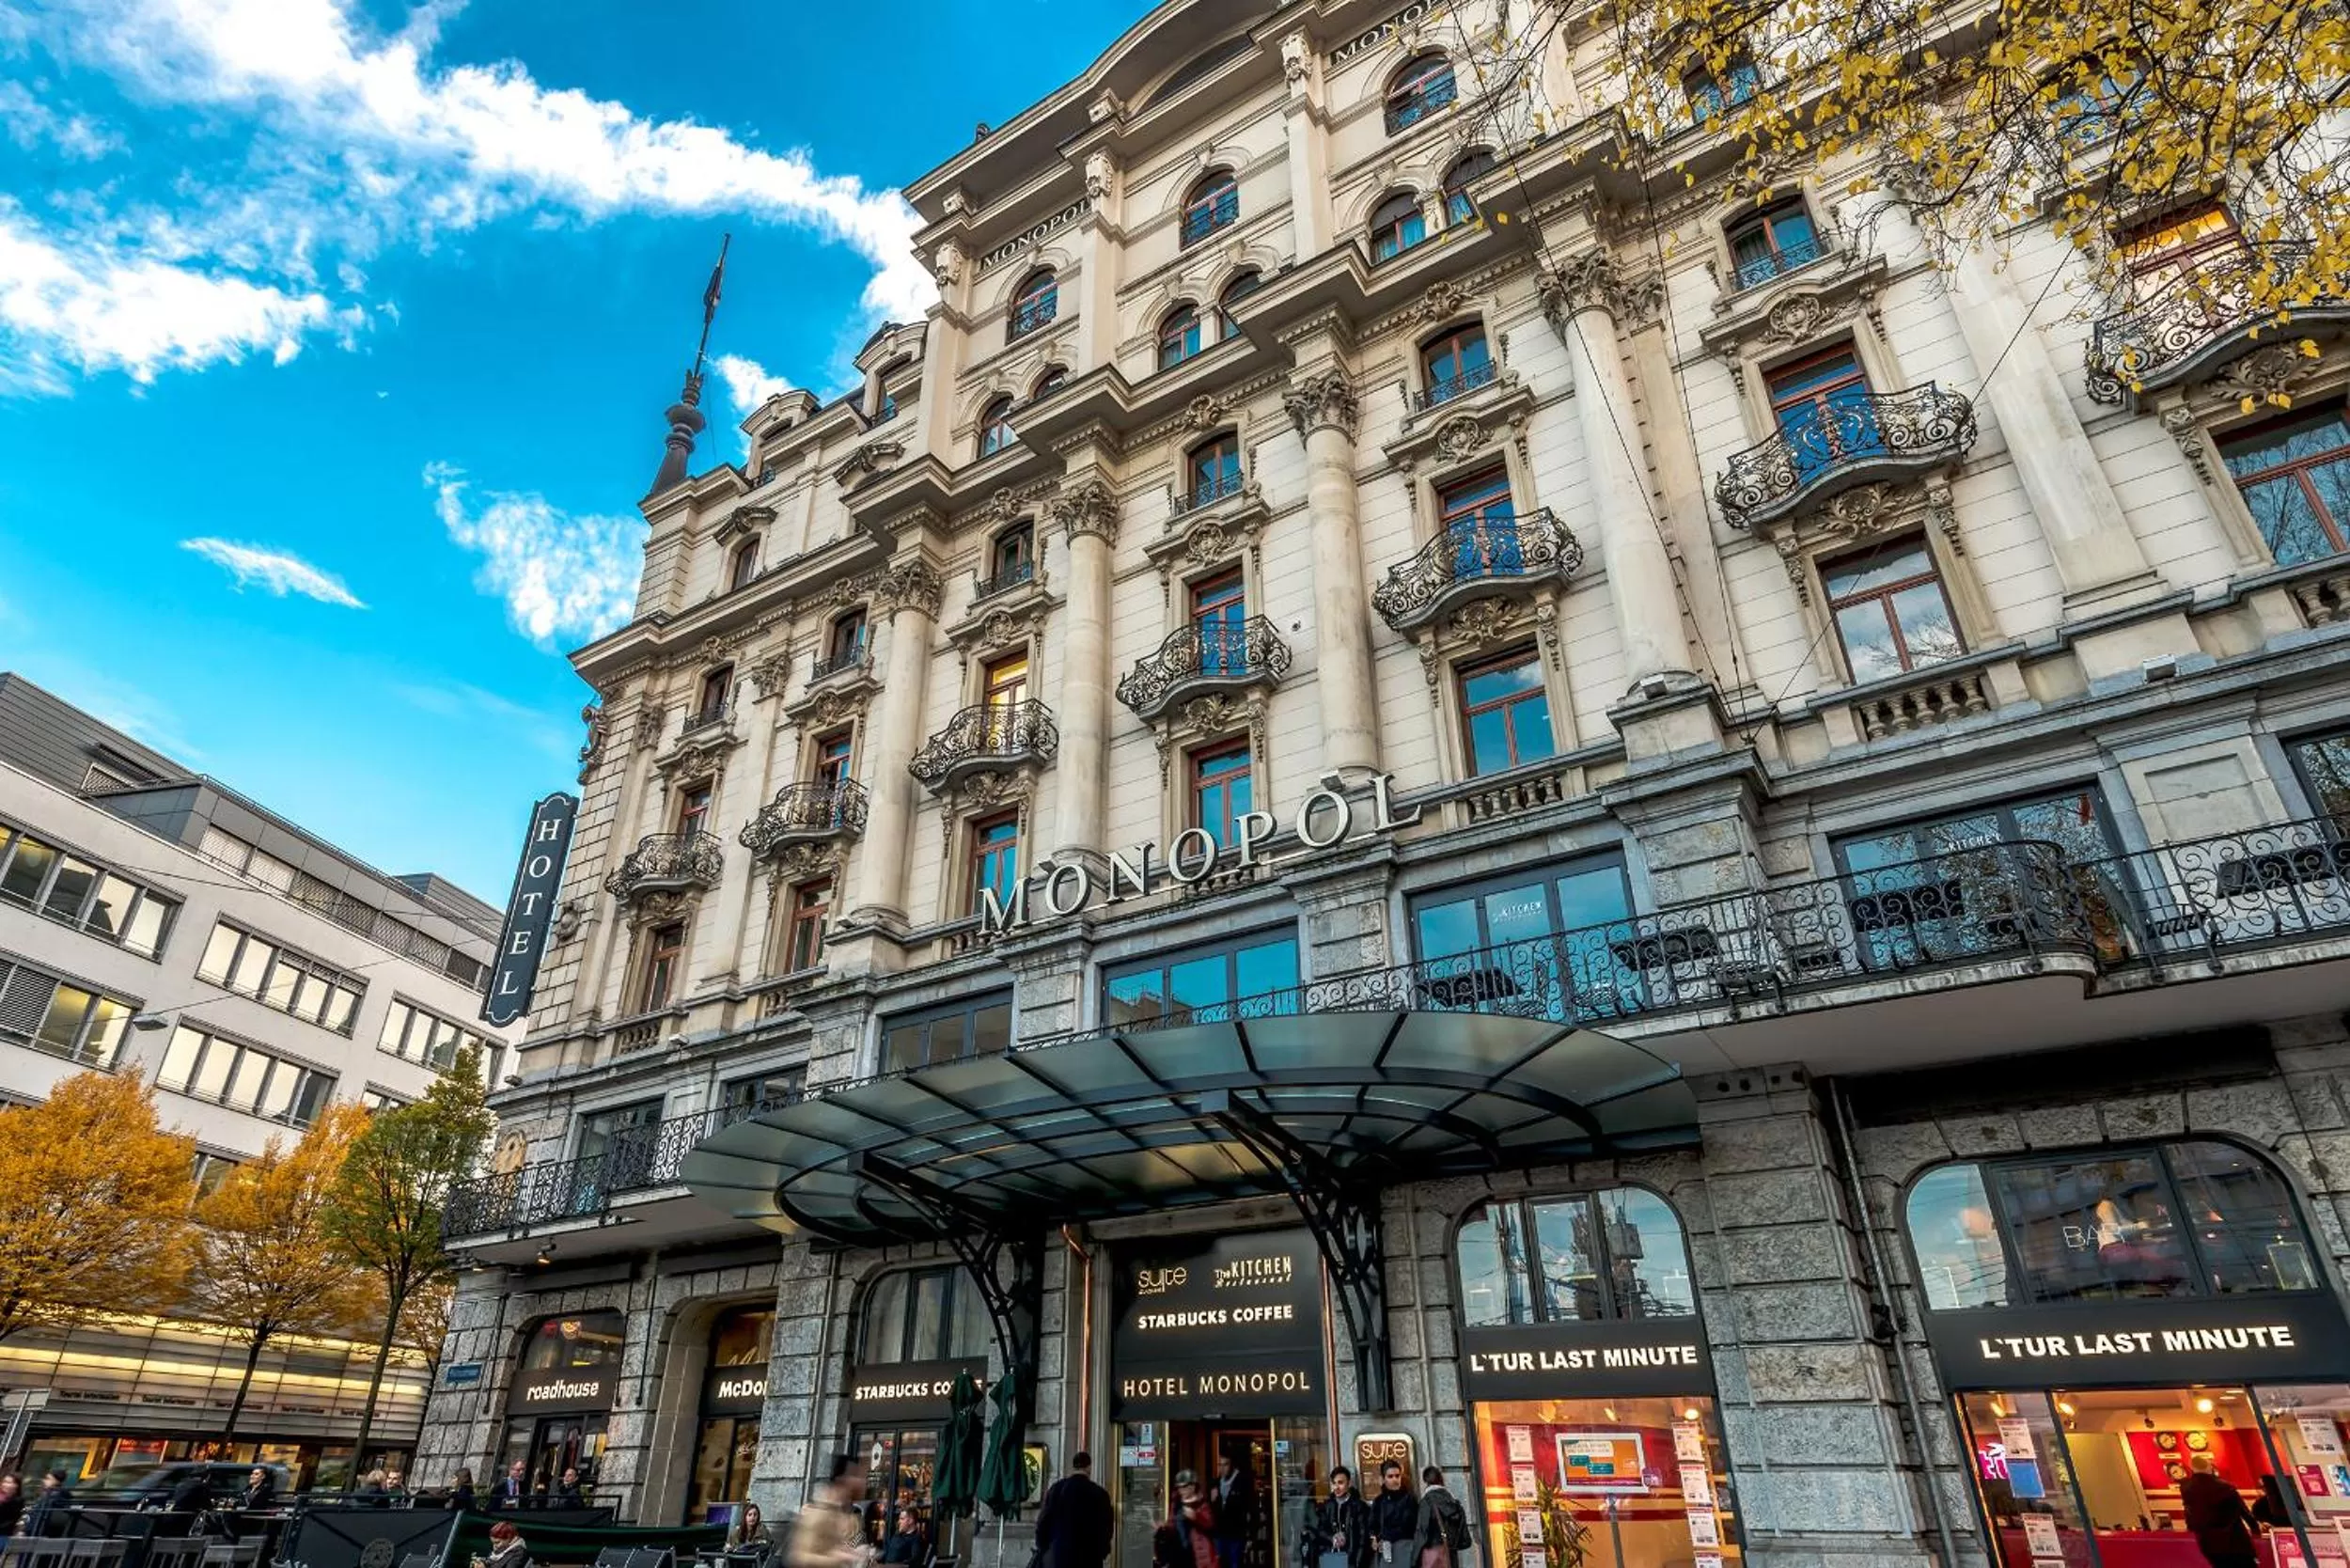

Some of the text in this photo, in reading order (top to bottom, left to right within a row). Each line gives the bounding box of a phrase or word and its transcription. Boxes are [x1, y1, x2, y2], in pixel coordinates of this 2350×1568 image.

[978, 775, 1422, 934] MONOPOL
[498, 818, 562, 996] HOTEL
[1231, 1256, 1292, 1278] KITCHEN
[1138, 1304, 1293, 1329] STARBUCKS COFFEE
[2074, 1332, 2154, 1356] LAST
[2162, 1326, 2295, 1352] MINUTE
[1539, 1350, 1597, 1370] LAST
[1604, 1345, 1699, 1368] MINUTE
[526, 1380, 600, 1401] roadhouse
[854, 1383, 929, 1400] STARBUCKS
[1123, 1371, 1311, 1398] HOTEL MONOPOL
